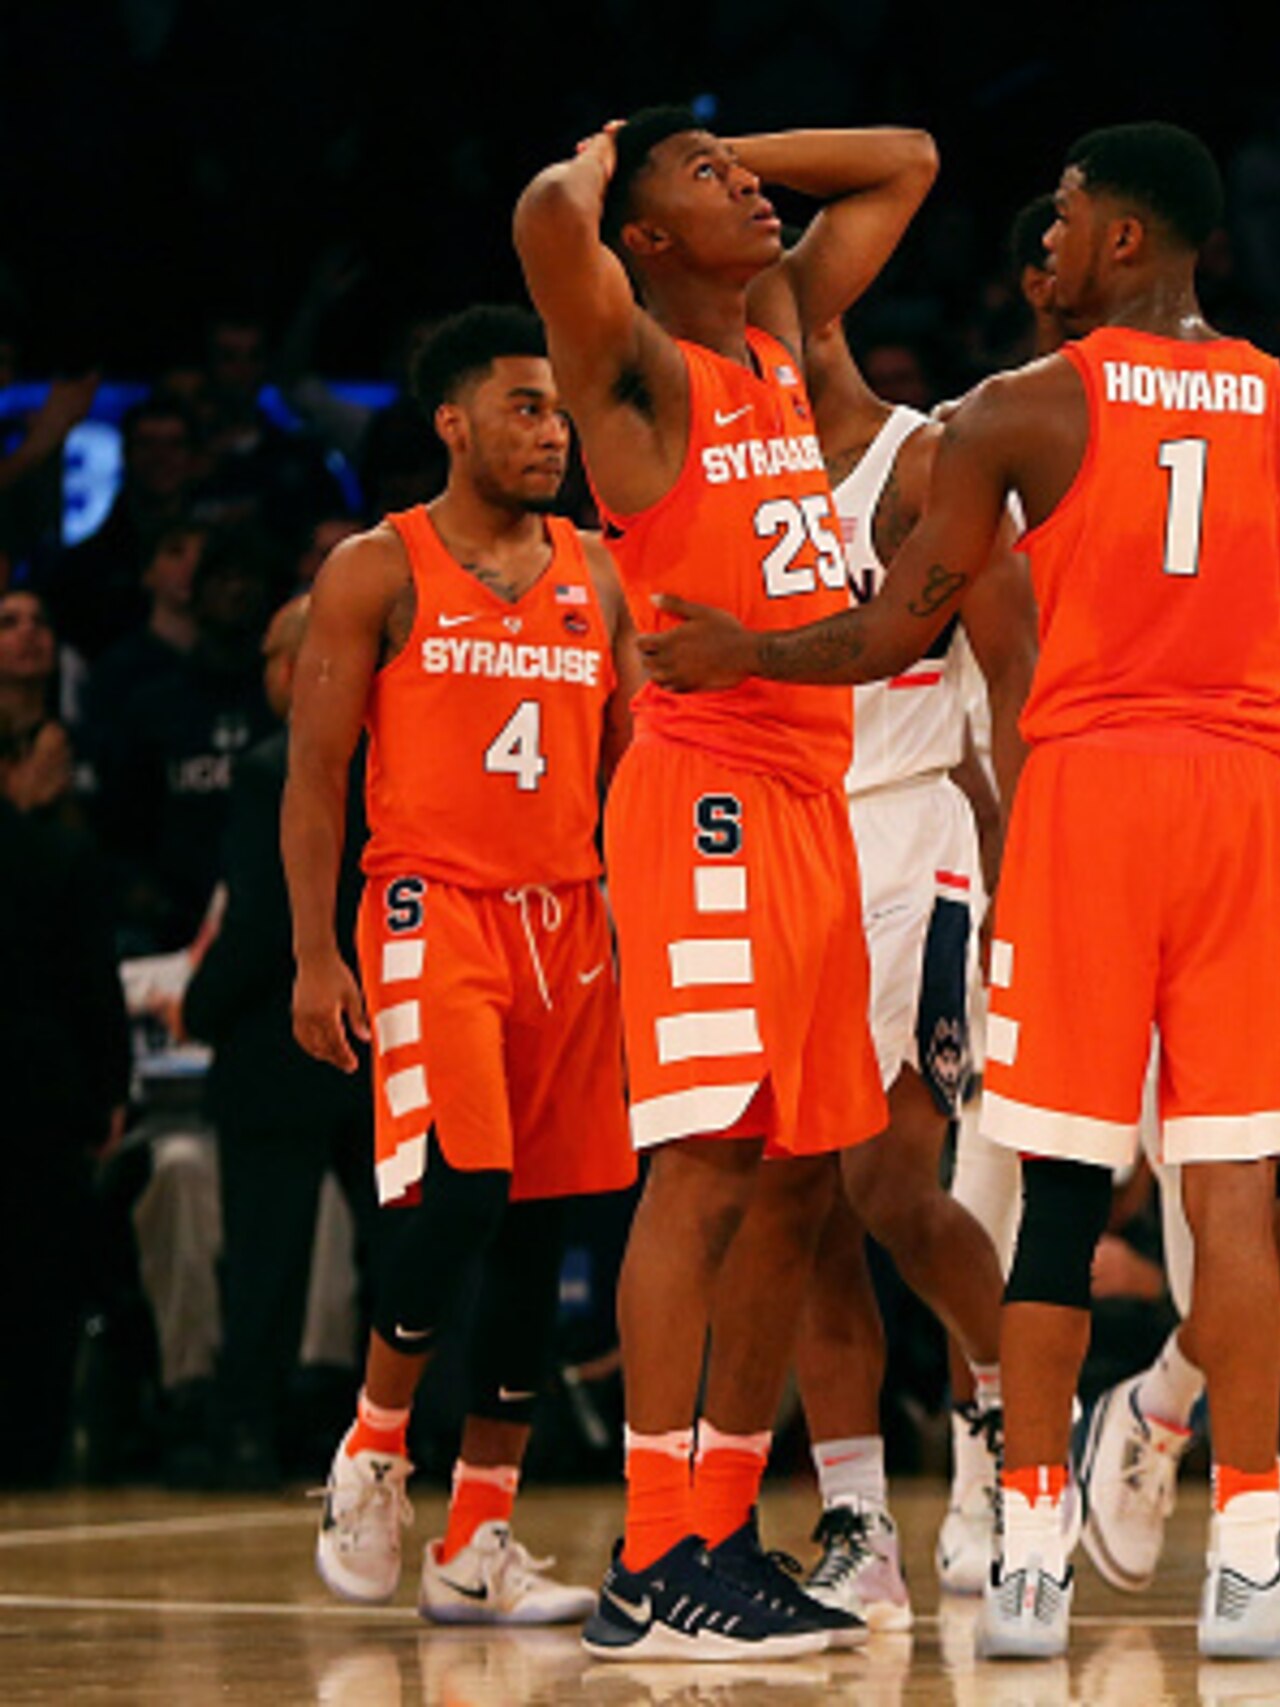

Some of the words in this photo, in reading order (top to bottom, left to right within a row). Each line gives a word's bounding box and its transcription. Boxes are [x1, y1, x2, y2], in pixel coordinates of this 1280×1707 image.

[1103, 361, 1266, 415] HOWARD
[1158, 438, 1208, 575] 1
[753, 494, 846, 598] 25
[421, 637, 599, 687] SYRACUSE
[484, 700, 547, 791] 4
[694, 794, 743, 858] S
[384, 876, 427, 933] S
